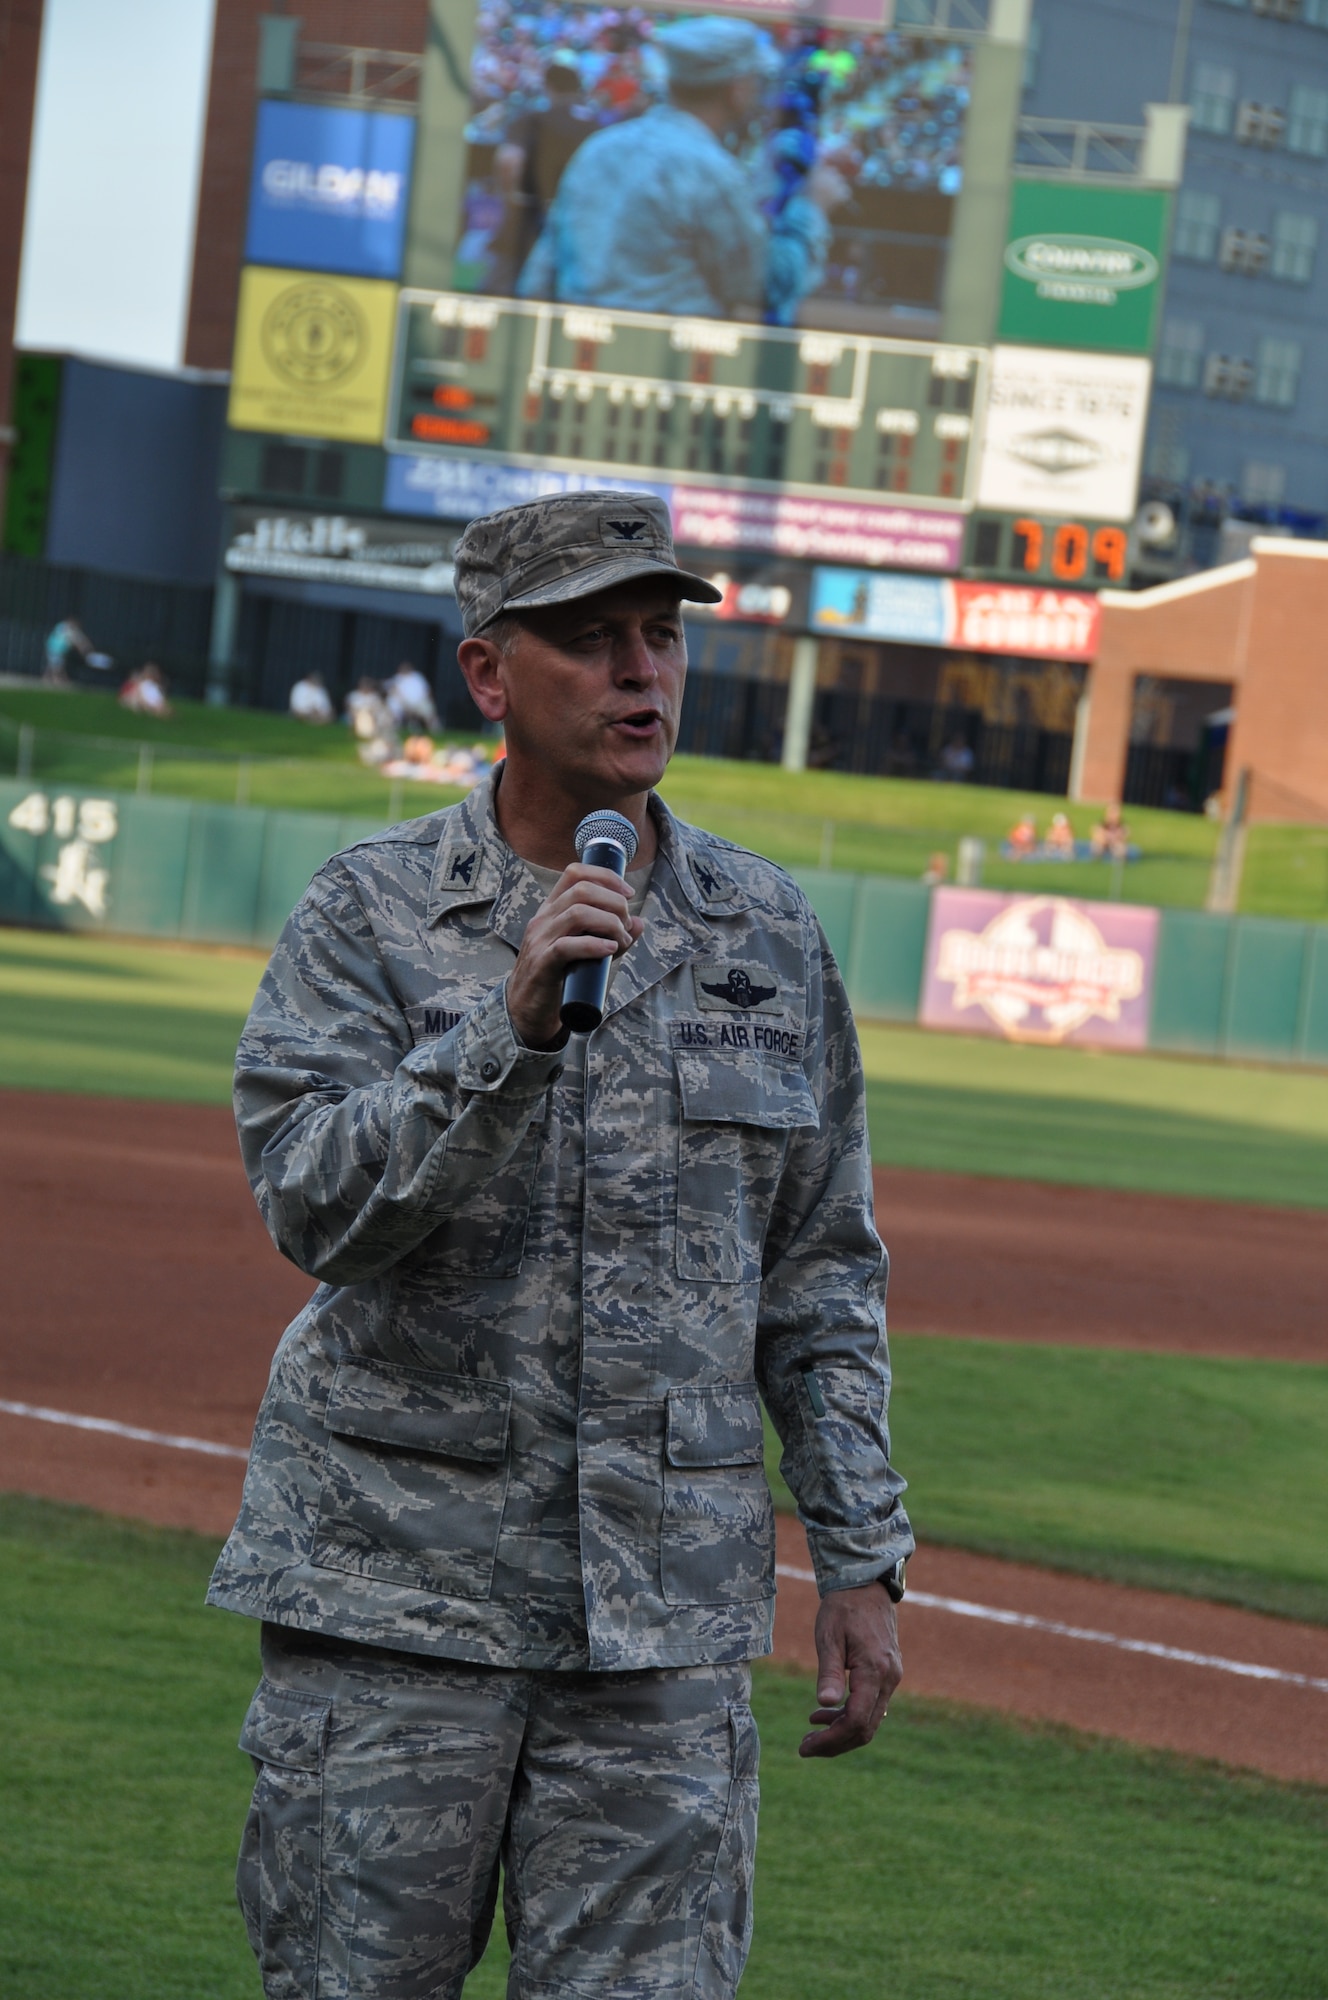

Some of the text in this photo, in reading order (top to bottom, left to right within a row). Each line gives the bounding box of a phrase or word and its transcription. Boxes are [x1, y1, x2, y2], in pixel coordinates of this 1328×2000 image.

[8, 791, 118, 843] 415
[681, 1022, 799, 1056] U.S. AIR FORCE
